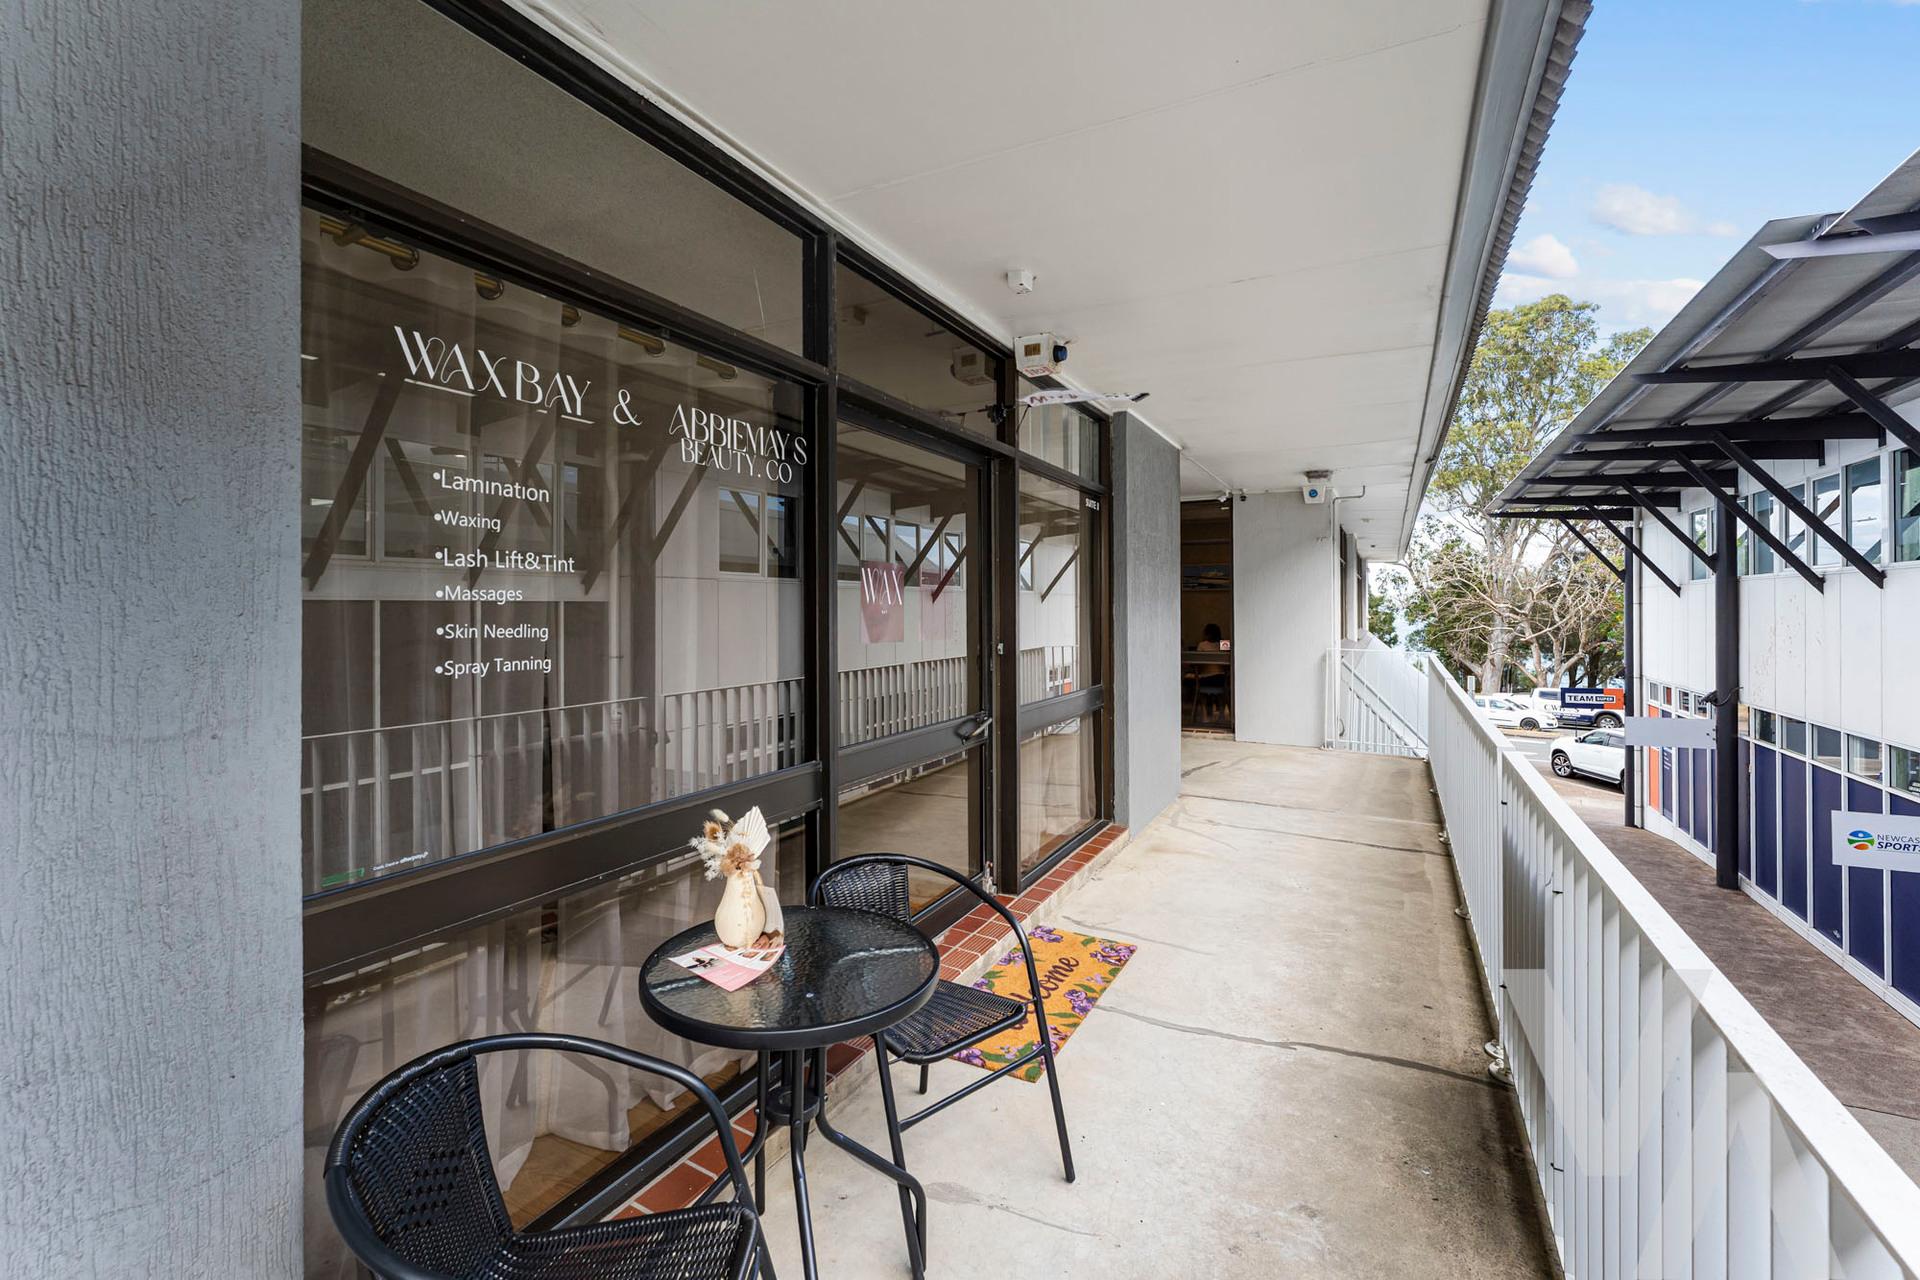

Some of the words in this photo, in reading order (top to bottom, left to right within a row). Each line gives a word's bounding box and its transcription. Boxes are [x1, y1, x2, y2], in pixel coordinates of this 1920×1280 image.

[612, 388, 643, 426] &
[441, 468, 550, 503] Lamination
[441, 509, 501, 532] Waxing
[443, 547, 488, 568] Lash
[444, 585, 523, 605] Massages
[444, 623, 478, 640] Skin
[483, 624, 549, 642] Needling
[443, 659, 490, 679] Spray
[493, 656, 552, 673] Tanning
[1567, 694, 1594, 702] TEAM
